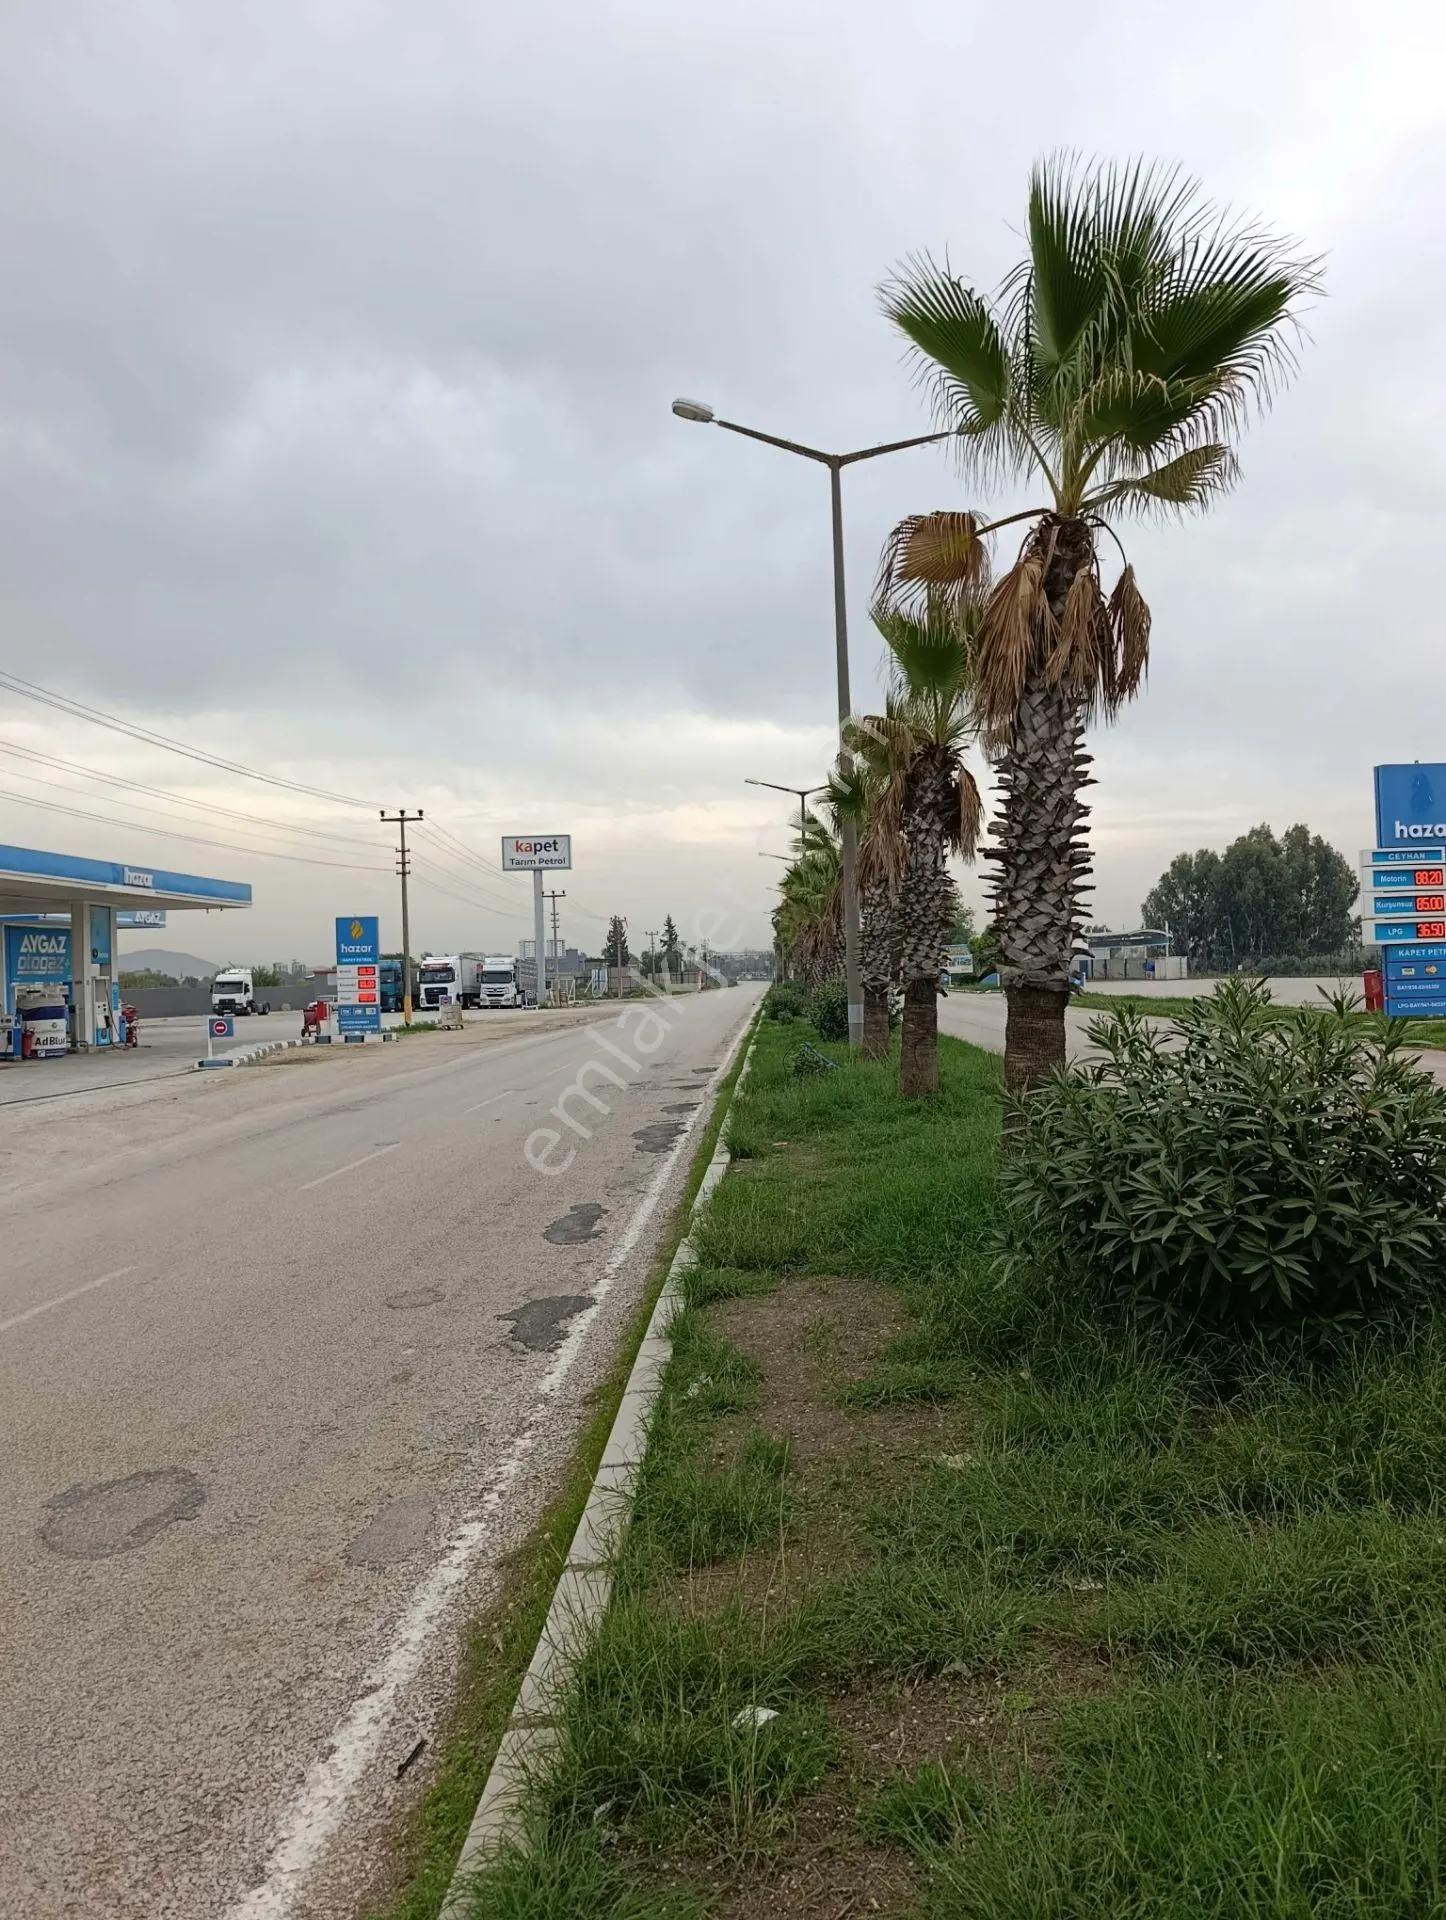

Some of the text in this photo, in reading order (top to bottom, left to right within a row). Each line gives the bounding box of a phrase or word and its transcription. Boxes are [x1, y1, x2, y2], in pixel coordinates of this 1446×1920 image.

[515, 839, 559, 855] kapet
[538, 857, 566, 865] Petrol
[1380, 875, 1407, 883] Motorin
[135, 910, 161, 924] AYGAZ
[1388, 928, 1404, 936] LPG
[20, 934, 67, 954] AYGAZ
[341, 943, 373, 953] hazar
[1398, 948, 1426, 957] KAPET
[17, 955, 65, 970] otogaz
